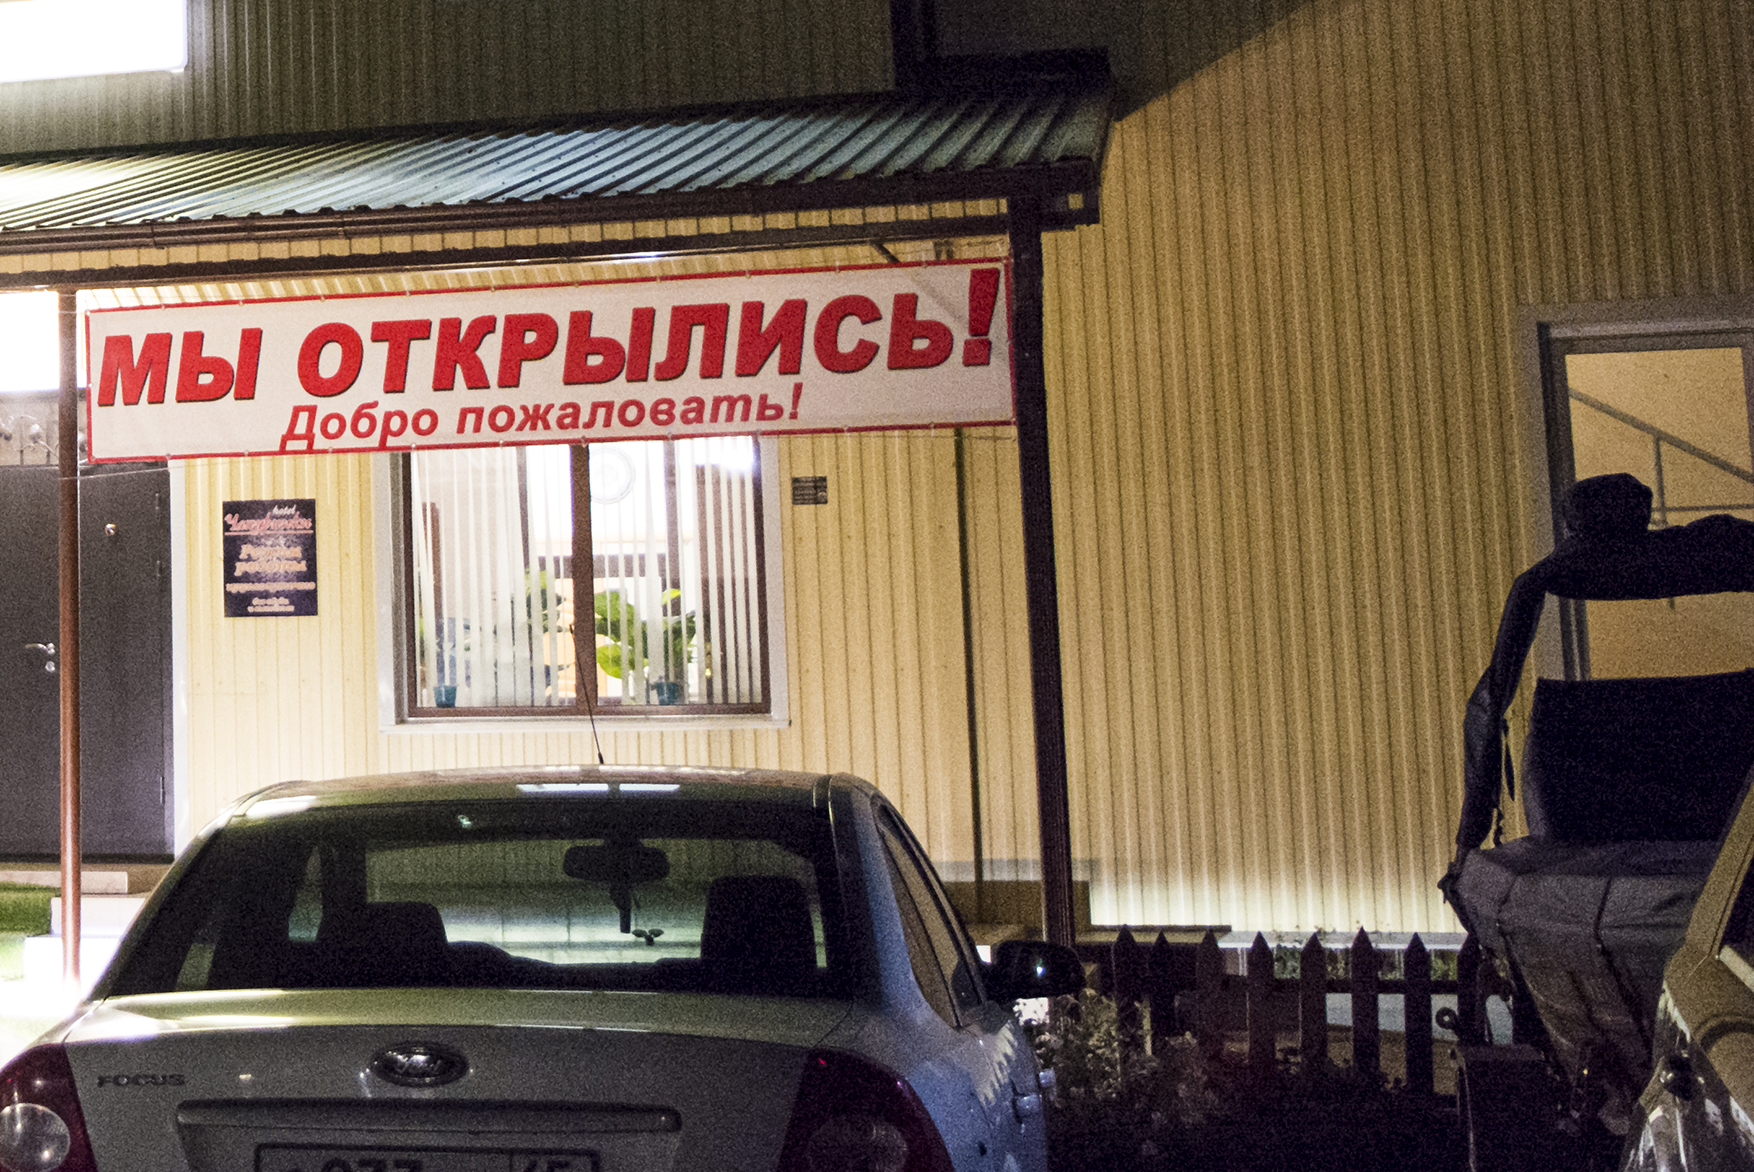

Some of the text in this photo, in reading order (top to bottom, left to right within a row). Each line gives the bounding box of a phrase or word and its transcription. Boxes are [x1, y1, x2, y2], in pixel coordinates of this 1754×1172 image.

[97, 267, 1000, 406] МЫ ОТКРЫЛИСЬ!
[279, 383, 804, 451] Добро пожаловать!
[97, 1073, 186, 1088] FOCUS
